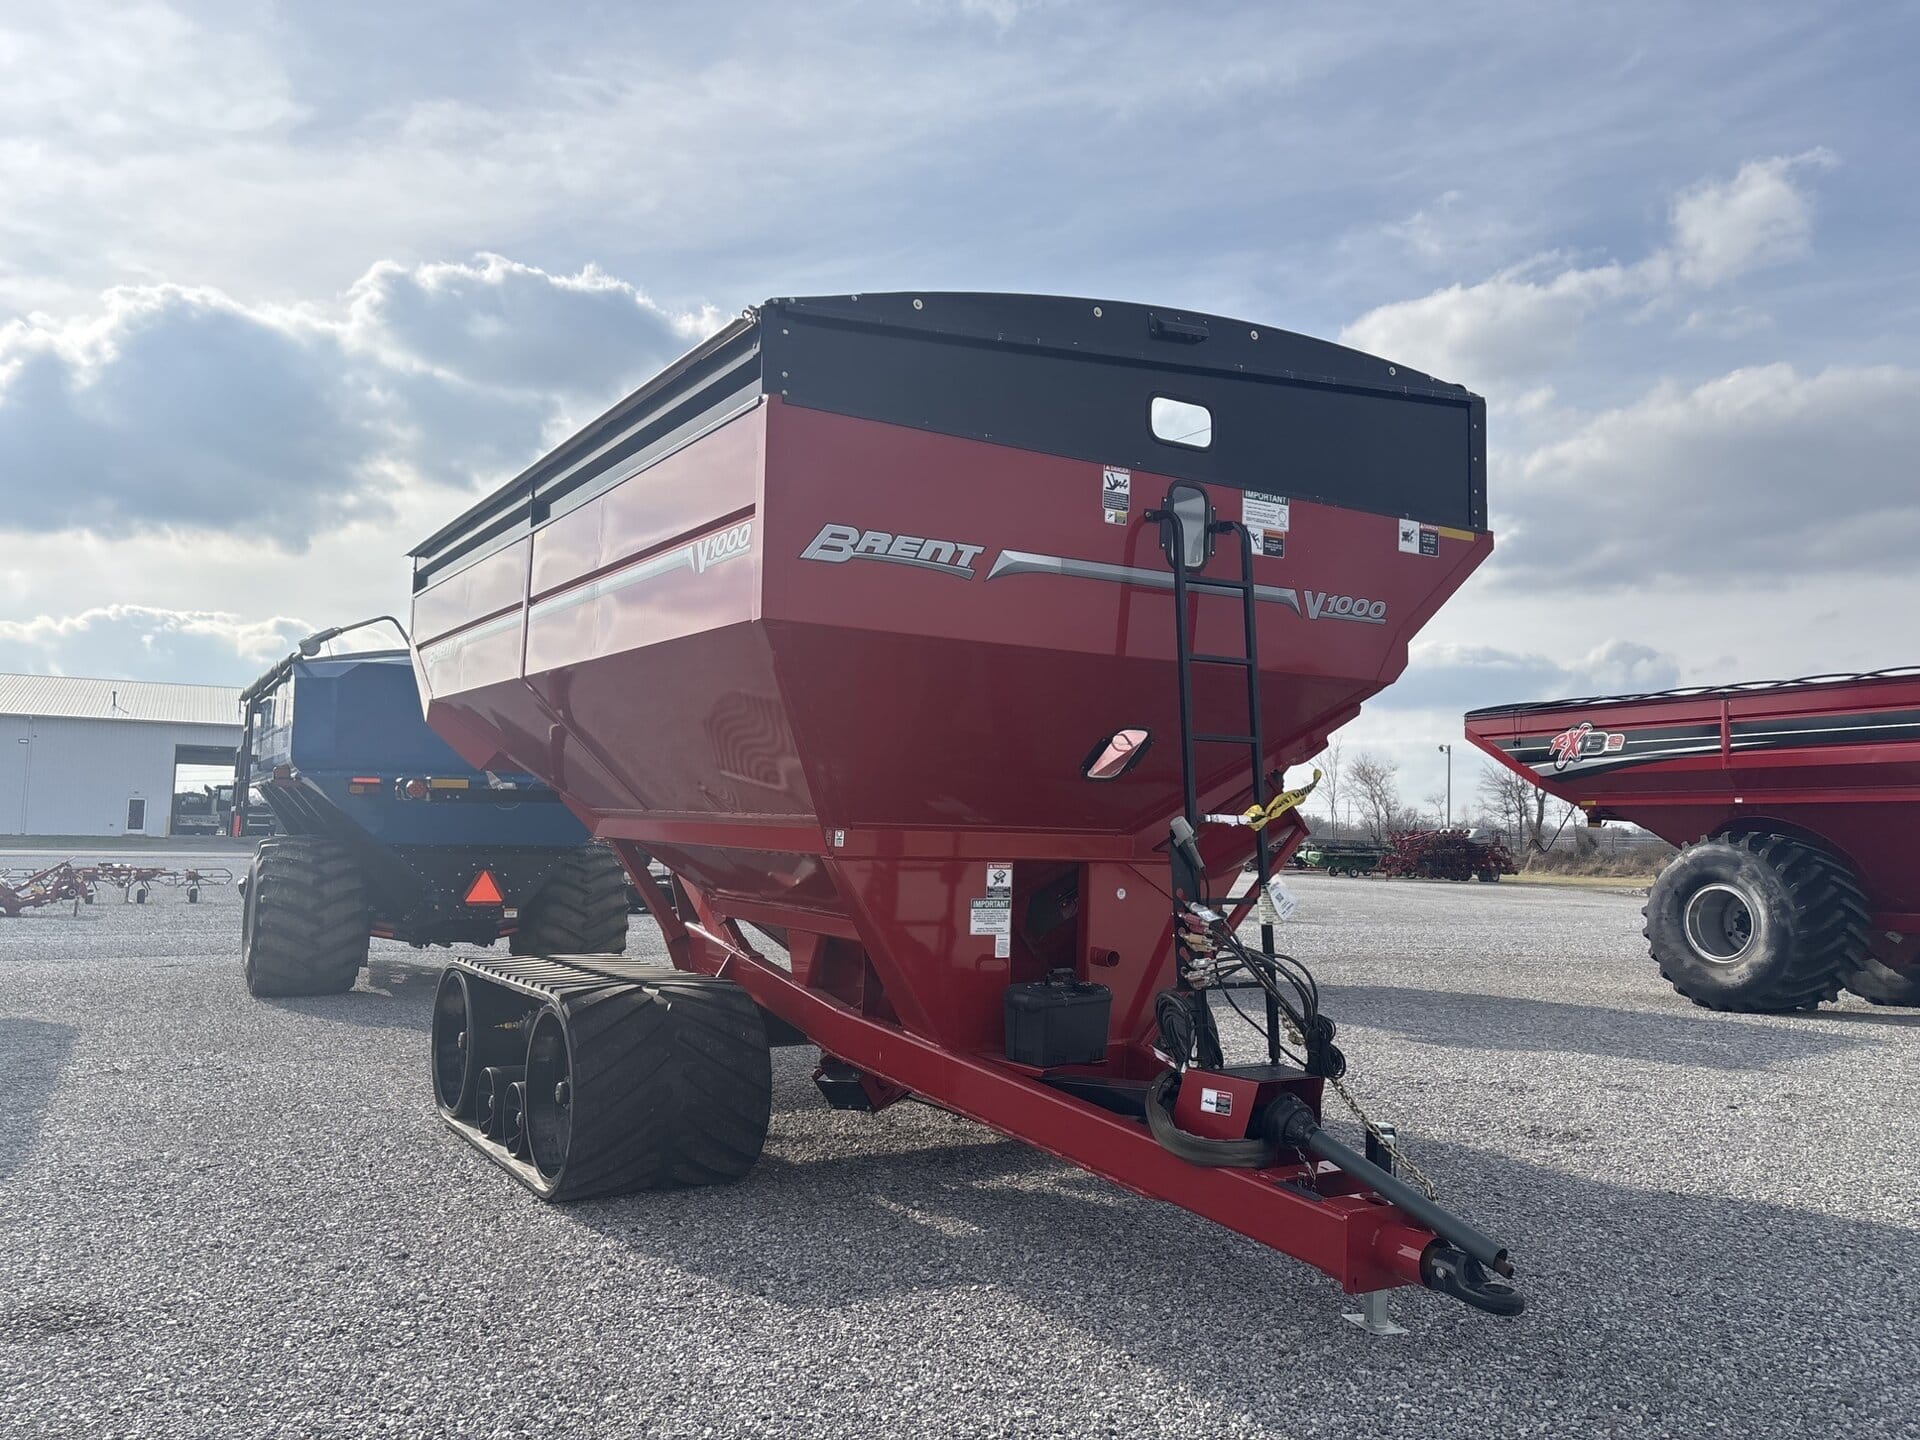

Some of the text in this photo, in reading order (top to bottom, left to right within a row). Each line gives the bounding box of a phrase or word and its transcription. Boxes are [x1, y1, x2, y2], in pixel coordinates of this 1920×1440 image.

[1245, 490, 1287, 504] IMPORTANT
[697, 523, 752, 573] V1000
[799, 523, 985, 571] BRENT
[1304, 590, 1387, 621] V1000
[973, 900, 1009, 908] IMPORTANT
